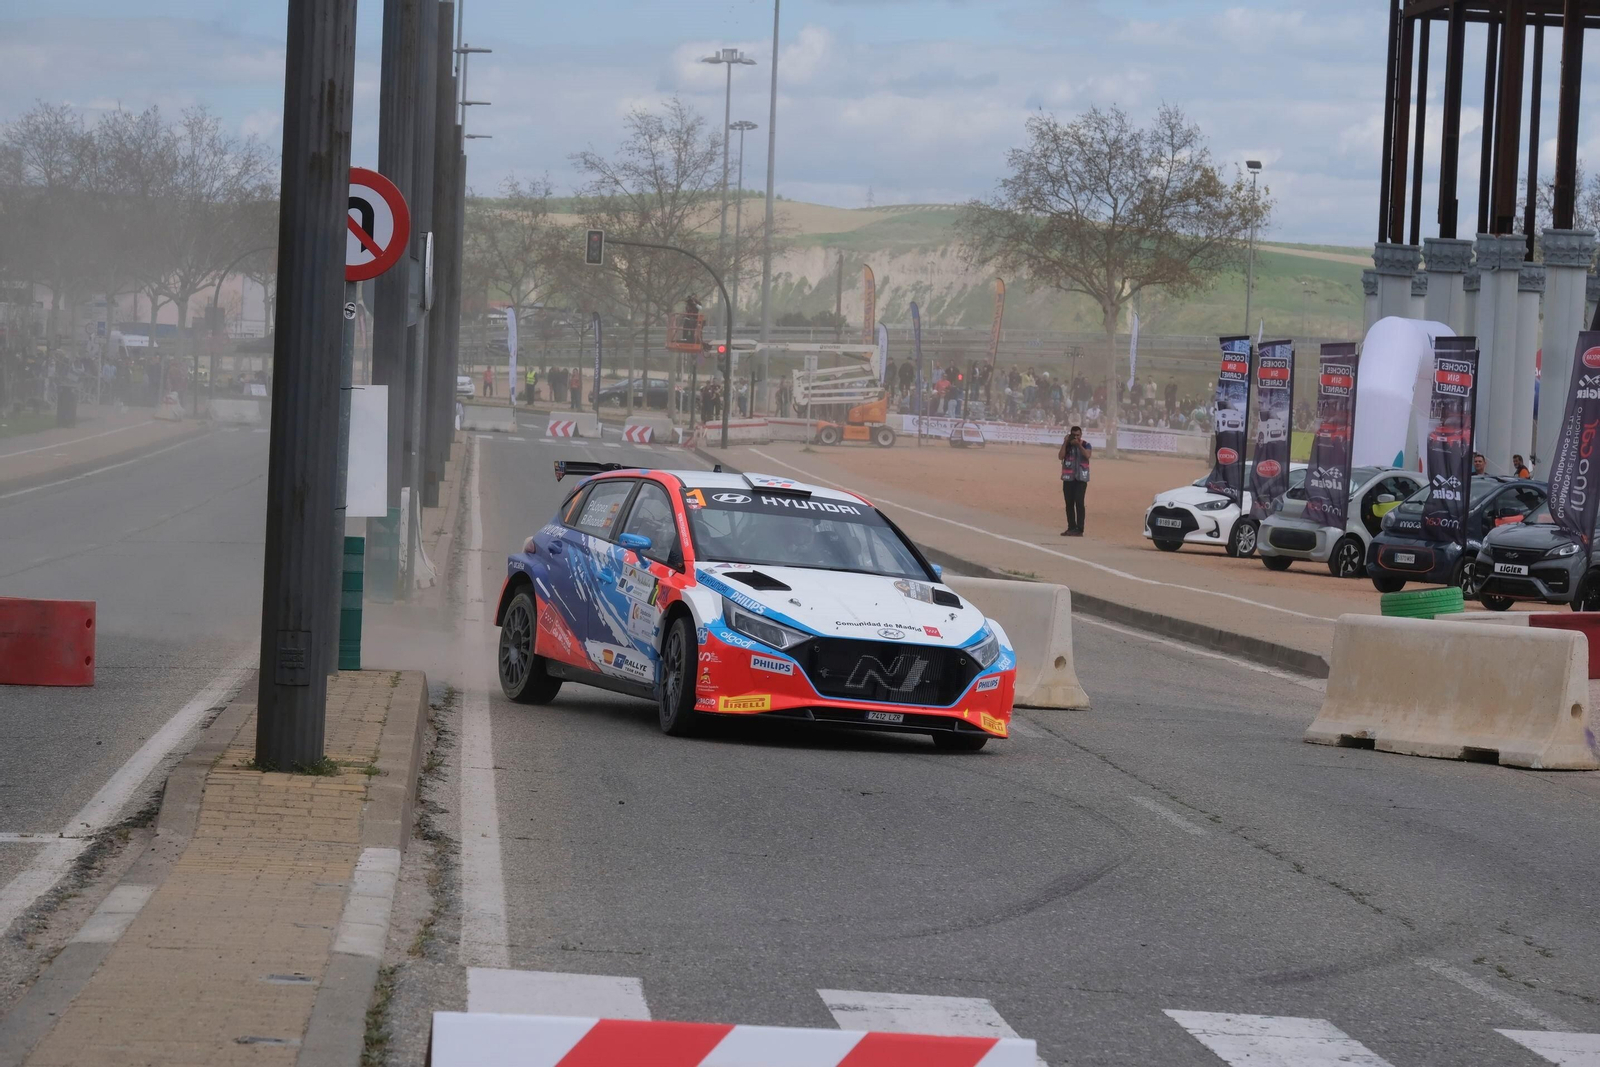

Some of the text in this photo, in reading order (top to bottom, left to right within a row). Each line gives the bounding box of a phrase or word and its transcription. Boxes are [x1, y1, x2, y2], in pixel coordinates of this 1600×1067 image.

[686, 488, 707, 507] 1
[761, 495, 862, 516] HYUNDAI
[705, 577, 767, 614] HYUNDAI PHILIPS
[836, 620, 881, 628] Comunidad
[895, 623, 922, 633] Madrid
[624, 659, 648, 672] RALLYE
[753, 658, 791, 672] PHILIPS
[978, 679, 998, 690] PHILIPS
[723, 697, 766, 709] PIRELLI
[871, 712, 902, 721] 7412 LZR
